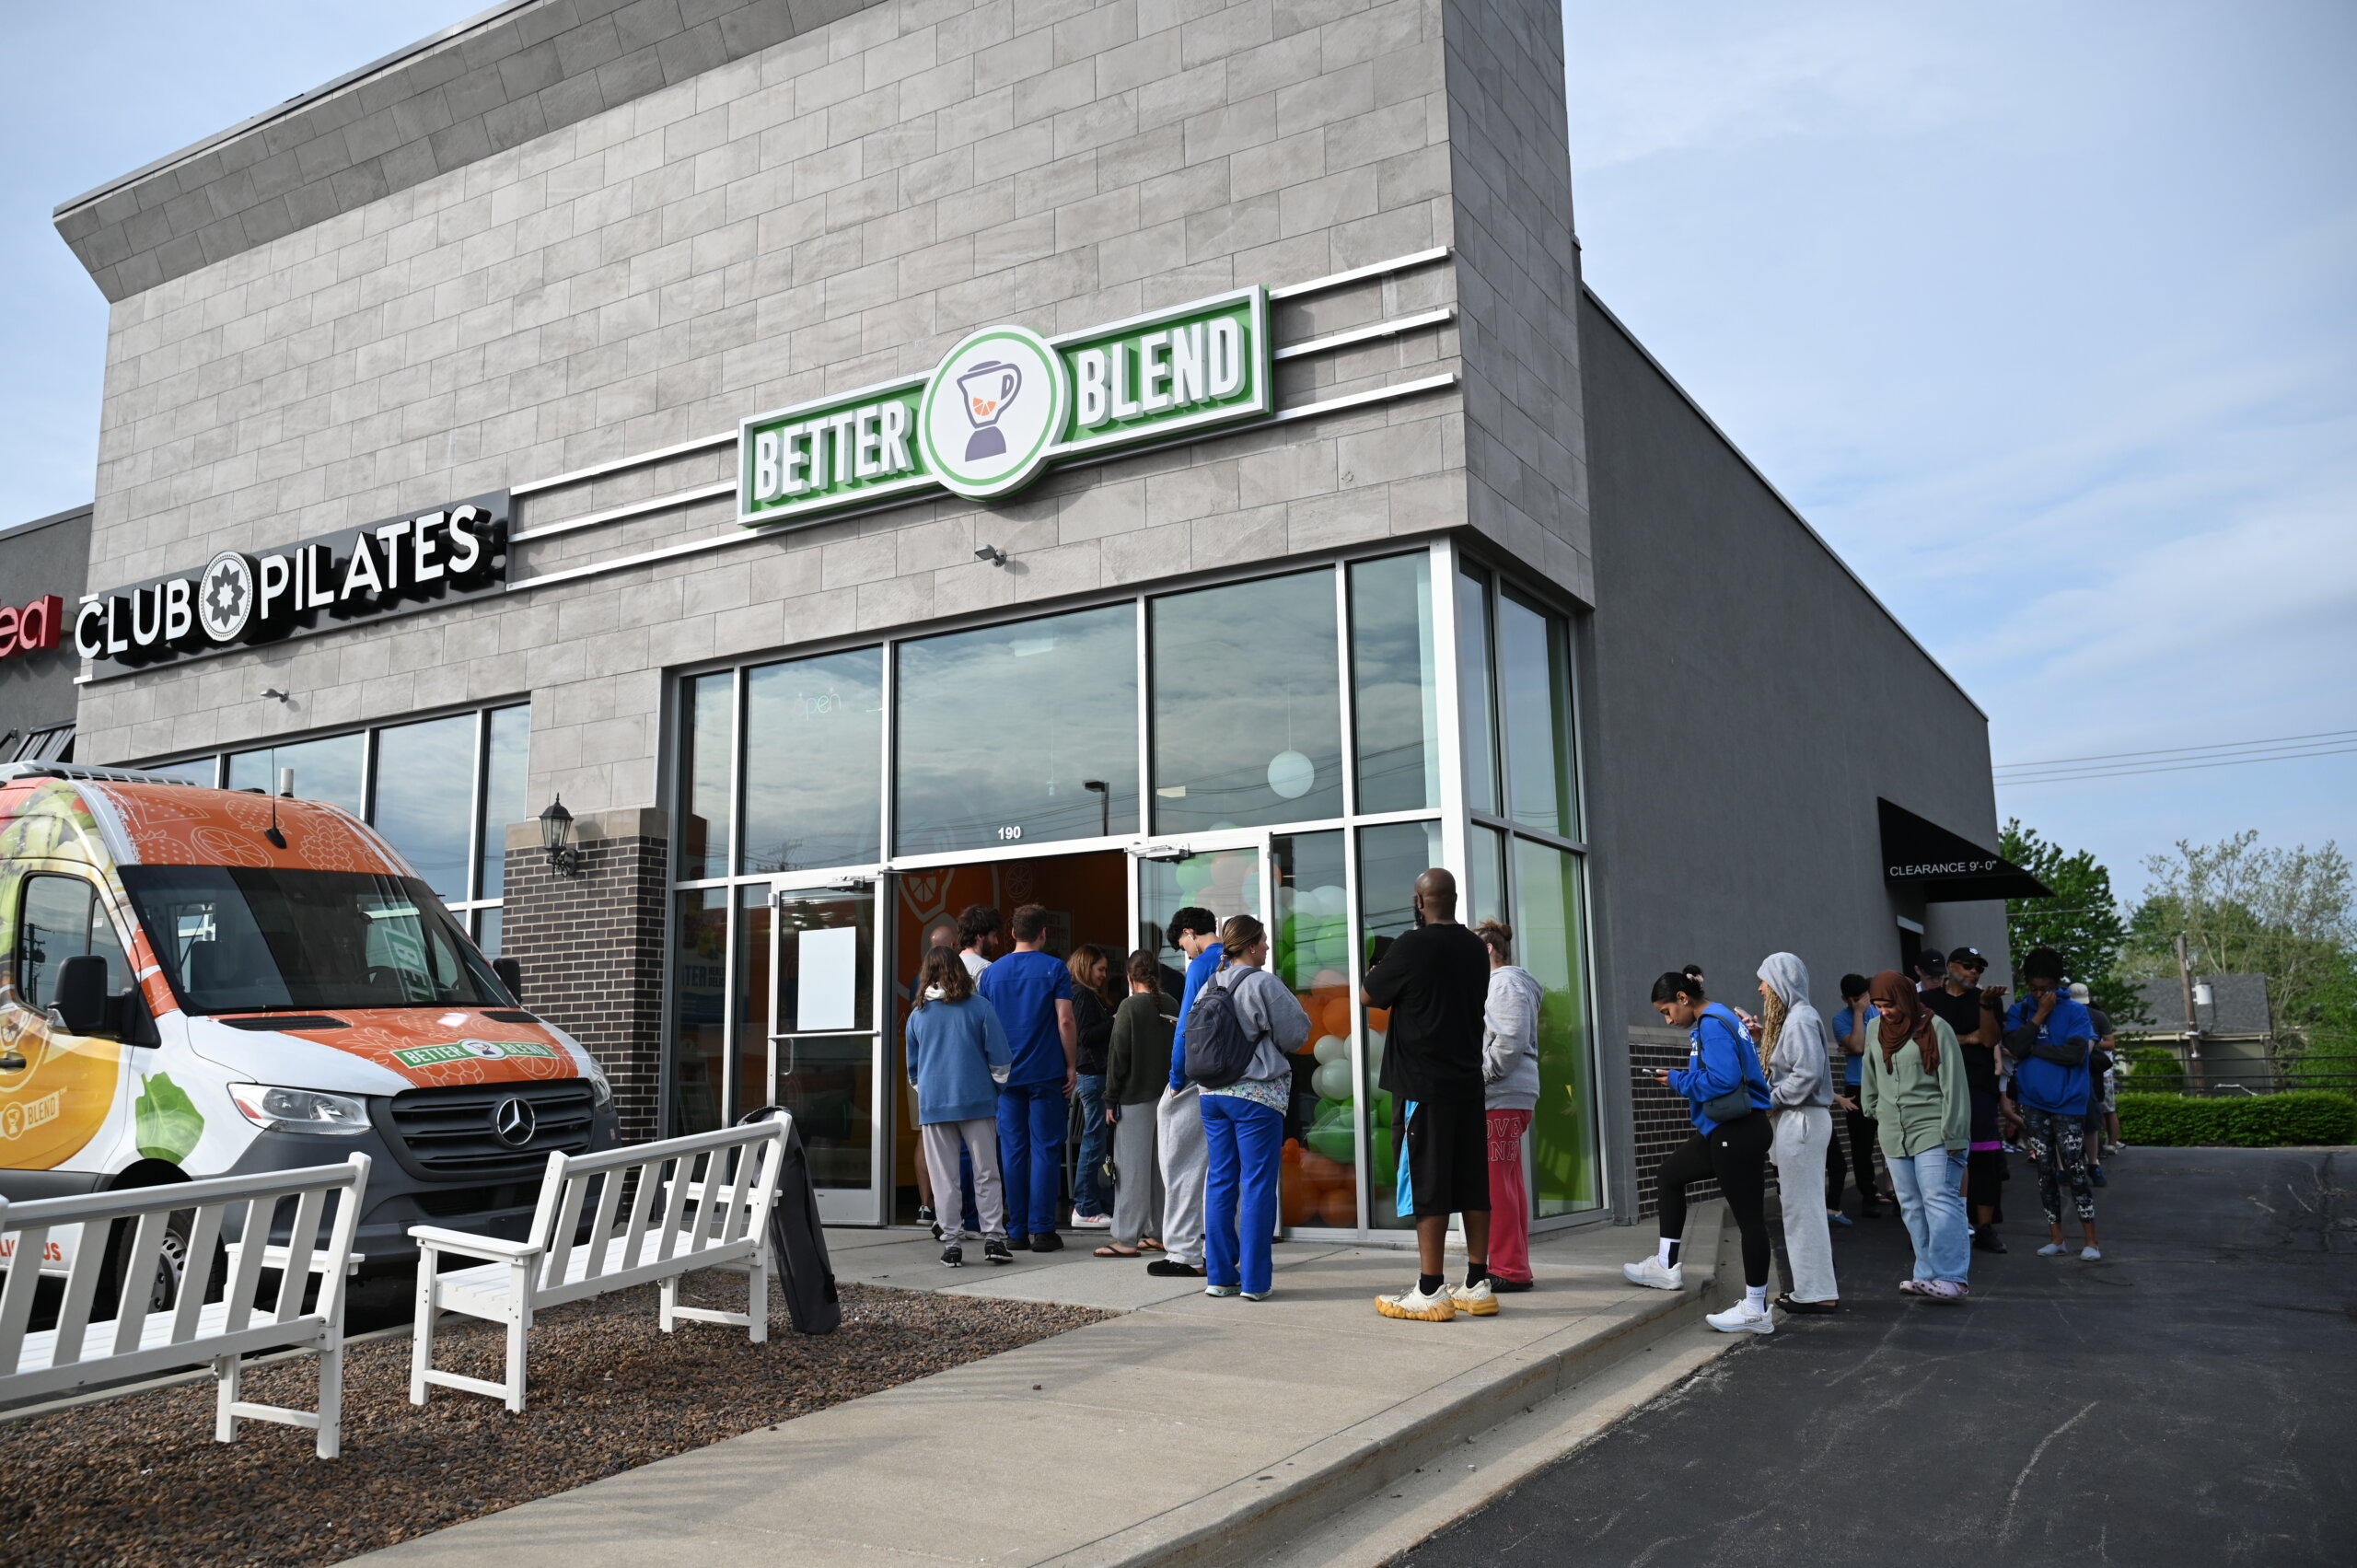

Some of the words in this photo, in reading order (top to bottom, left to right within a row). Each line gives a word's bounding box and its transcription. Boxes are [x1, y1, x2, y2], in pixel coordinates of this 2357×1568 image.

[754, 400, 910, 502] BETTER
[1077, 316, 1243, 427] BLEND
[75, 577, 192, 659] CLUB
[260, 505, 482, 620] PILATES
[998, 825, 1021, 840] 190
[1889, 862, 1966, 876] CLEARANCE
[402, 1046, 467, 1063] BETTER
[500, 1043, 549, 1055] BLEND
[28, 1097, 55, 1125] BLEND
